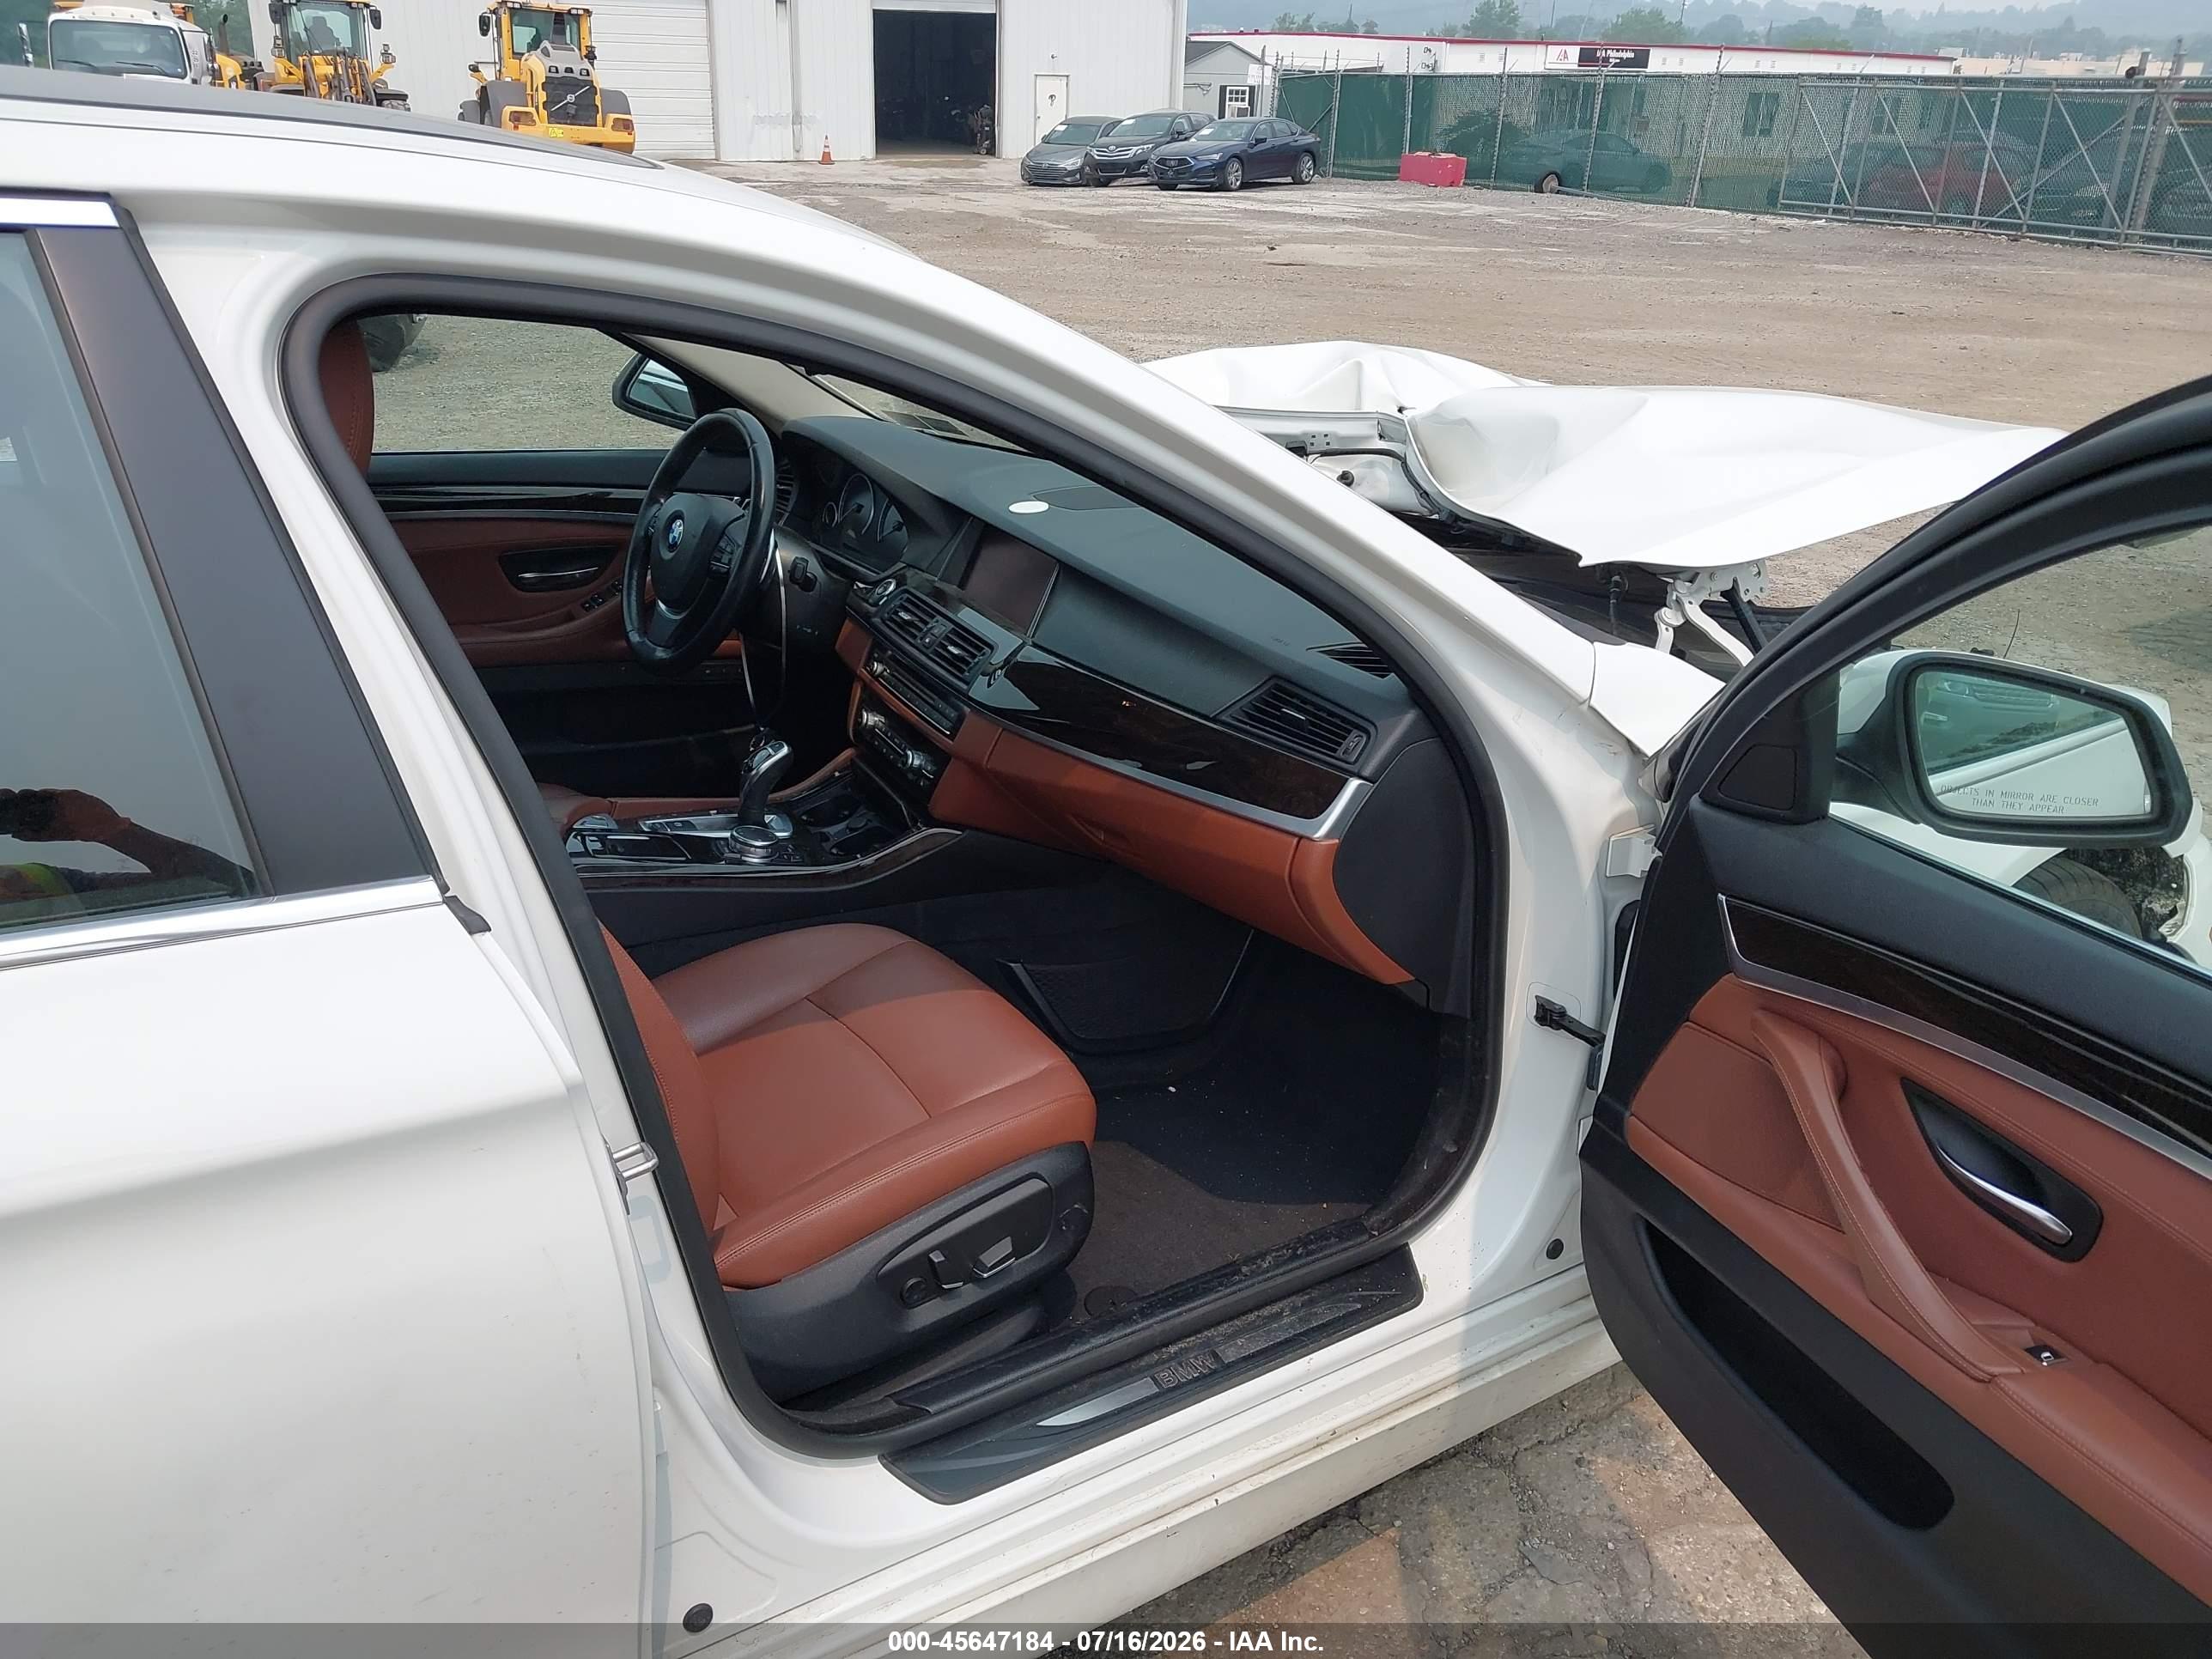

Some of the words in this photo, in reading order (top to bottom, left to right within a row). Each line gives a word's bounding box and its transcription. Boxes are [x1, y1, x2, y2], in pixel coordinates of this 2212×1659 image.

[1972, 798, 1995, 808] THAN
[2002, 800, 2024, 811] THEY
[2028, 803, 2065, 814] APPEAR
[1985, 789, 1995, 798] IN
[2000, 790, 2034, 802] MIRROR
[2039, 793, 2058, 804] ARE
[2063, 795, 2099, 807] CLOSER
[1153, 1351, 1218, 1389] BMW
